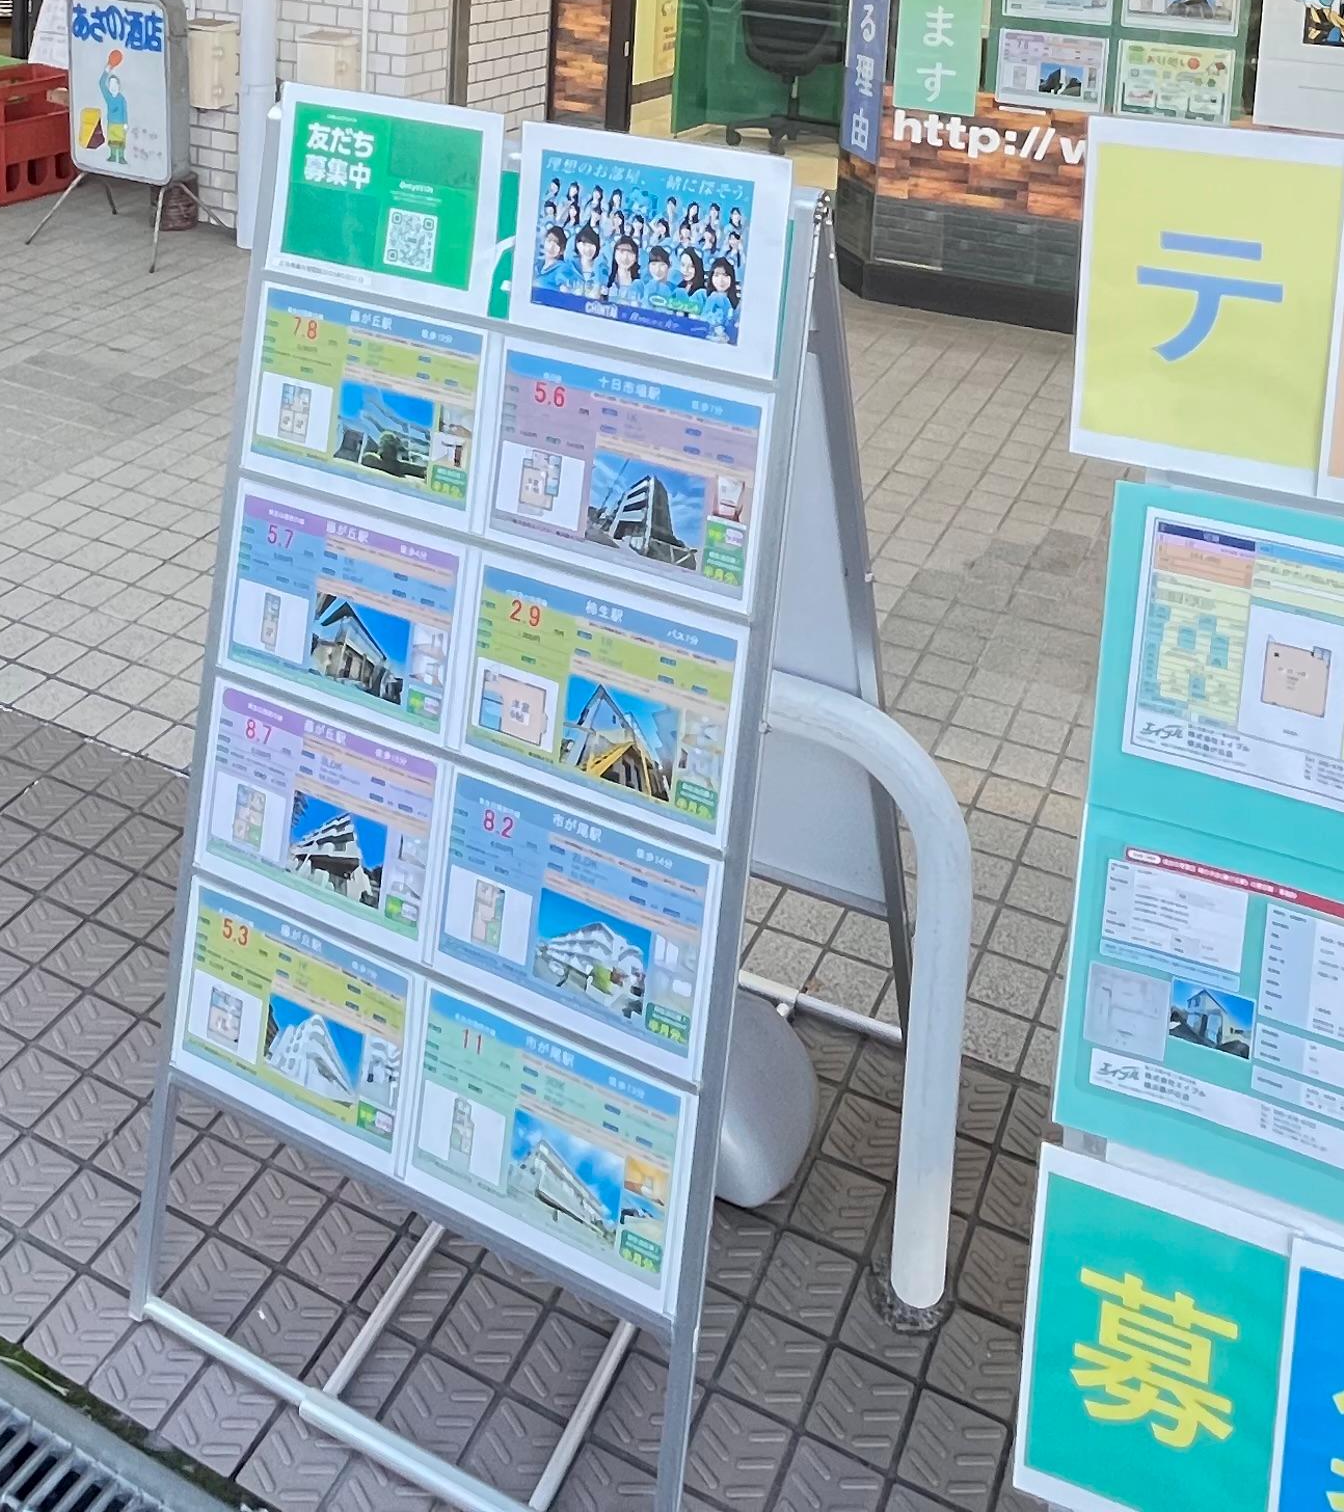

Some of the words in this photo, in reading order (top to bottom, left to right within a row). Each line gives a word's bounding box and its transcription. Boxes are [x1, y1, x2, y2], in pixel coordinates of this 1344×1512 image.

[72, 3, 165, 53] あさの酒店
[306, 121, 375, 159] 友だち
[303, 153, 372, 190] 募集中
[534, 380, 567, 408] 5.6
[267, 523, 295, 550] 5.7
[510, 599, 541, 627] 2.9
[246, 718, 273, 745] 8.7
[483, 809, 515, 839] 8.2
[222, 917, 249, 946] 5.3
